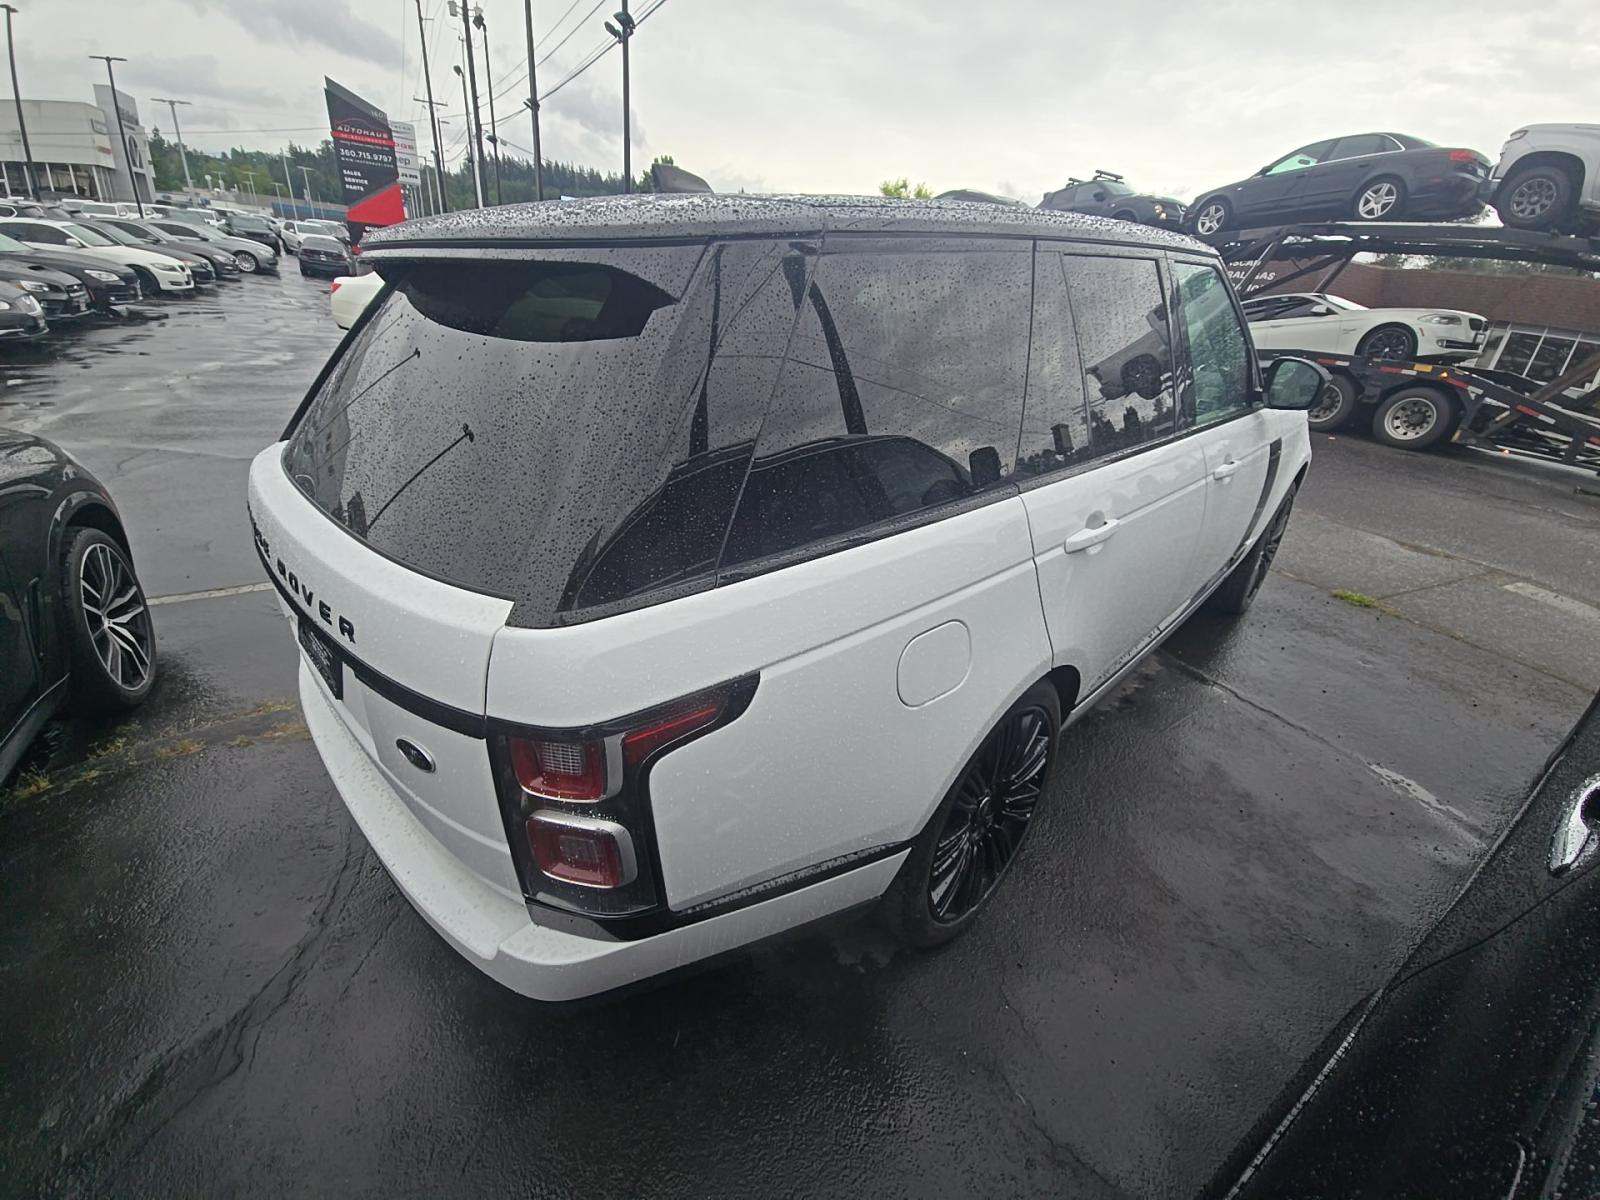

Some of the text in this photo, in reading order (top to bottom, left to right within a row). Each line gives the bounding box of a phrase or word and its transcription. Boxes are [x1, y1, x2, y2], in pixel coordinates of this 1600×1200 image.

[343, 169, 362, 177] SALES
[344, 176, 369, 185] SERVICE
[345, 184, 365, 192] PARTS
[277, 557, 356, 644] ROVER
